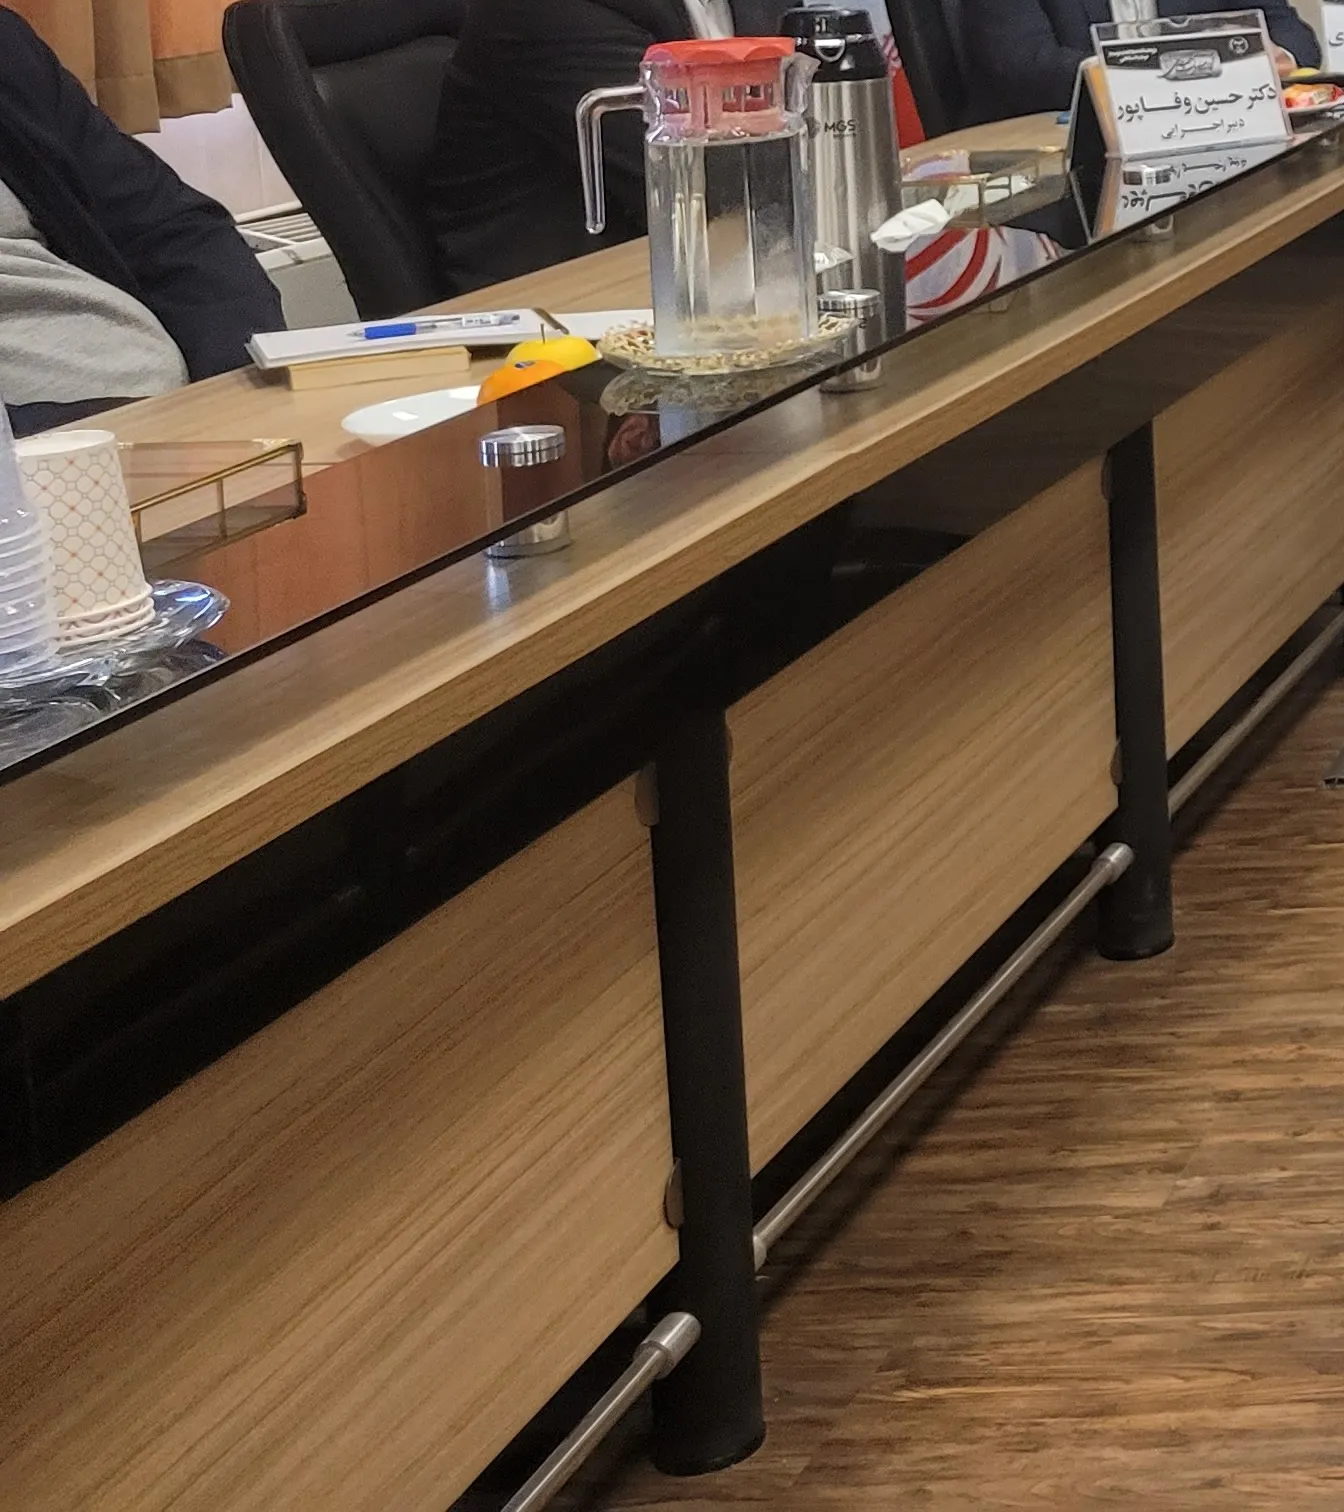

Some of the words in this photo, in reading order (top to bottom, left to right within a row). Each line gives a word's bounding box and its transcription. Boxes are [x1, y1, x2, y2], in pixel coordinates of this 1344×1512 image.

[1194, 91, 1244, 114] حسین
[1246, 83, 1278, 110] دکتر
[824, 119, 856, 133] MGS
